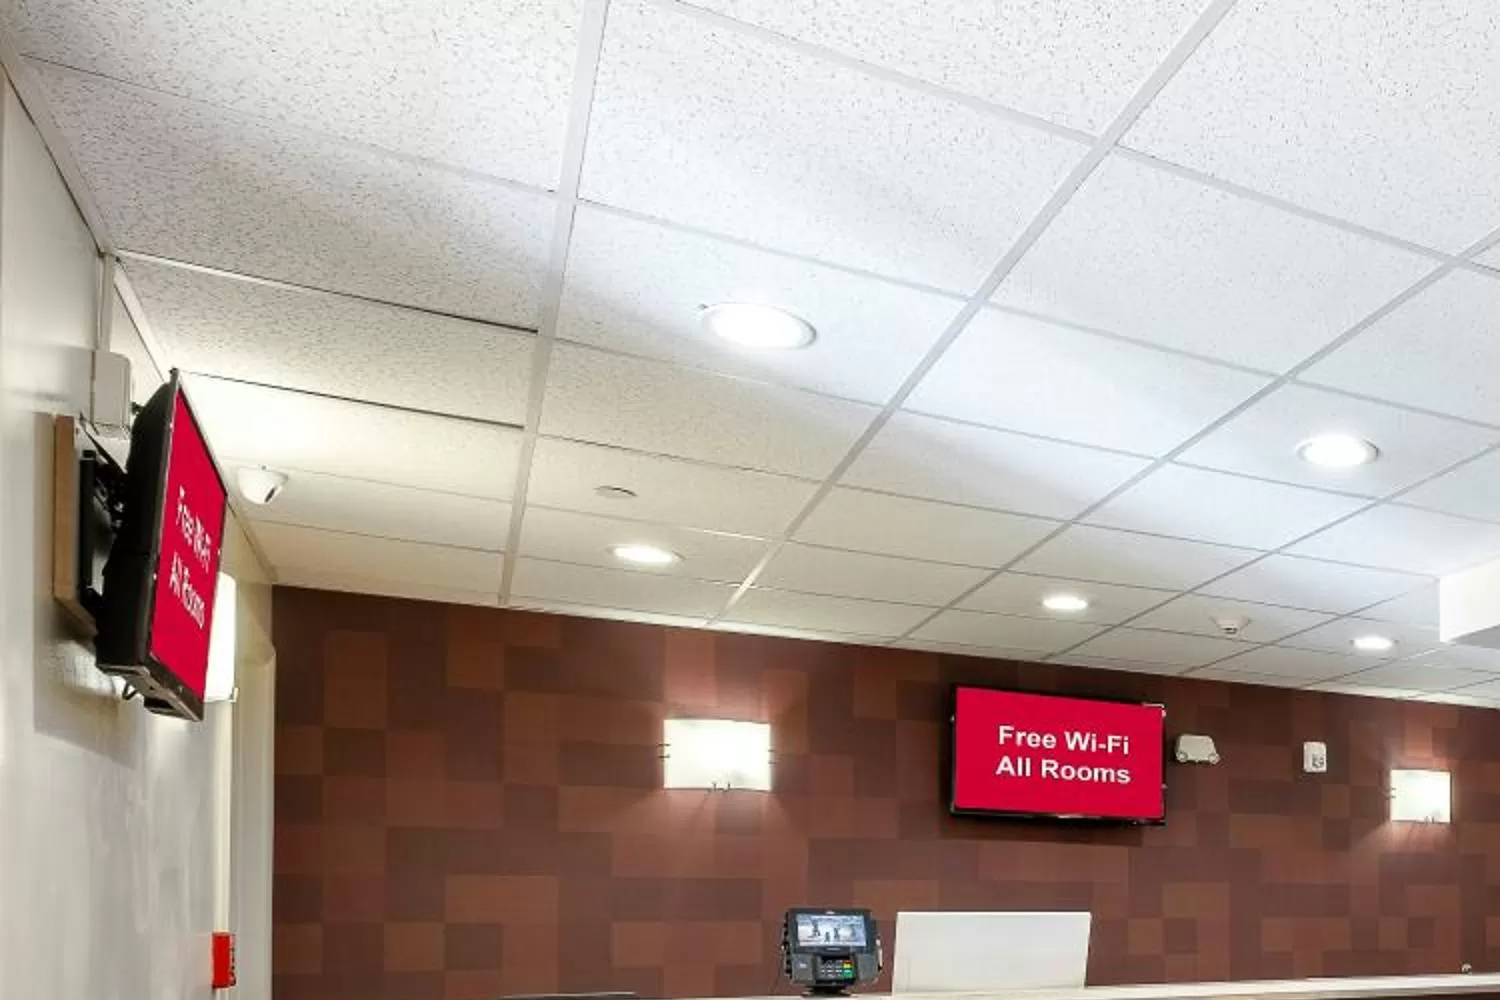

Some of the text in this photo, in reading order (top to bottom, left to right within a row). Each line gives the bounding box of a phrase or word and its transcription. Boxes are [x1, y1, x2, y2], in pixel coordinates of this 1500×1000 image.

[999, 725, 1129, 755] Free Wi-Fi
[995, 755, 1131, 784] All Rooms
